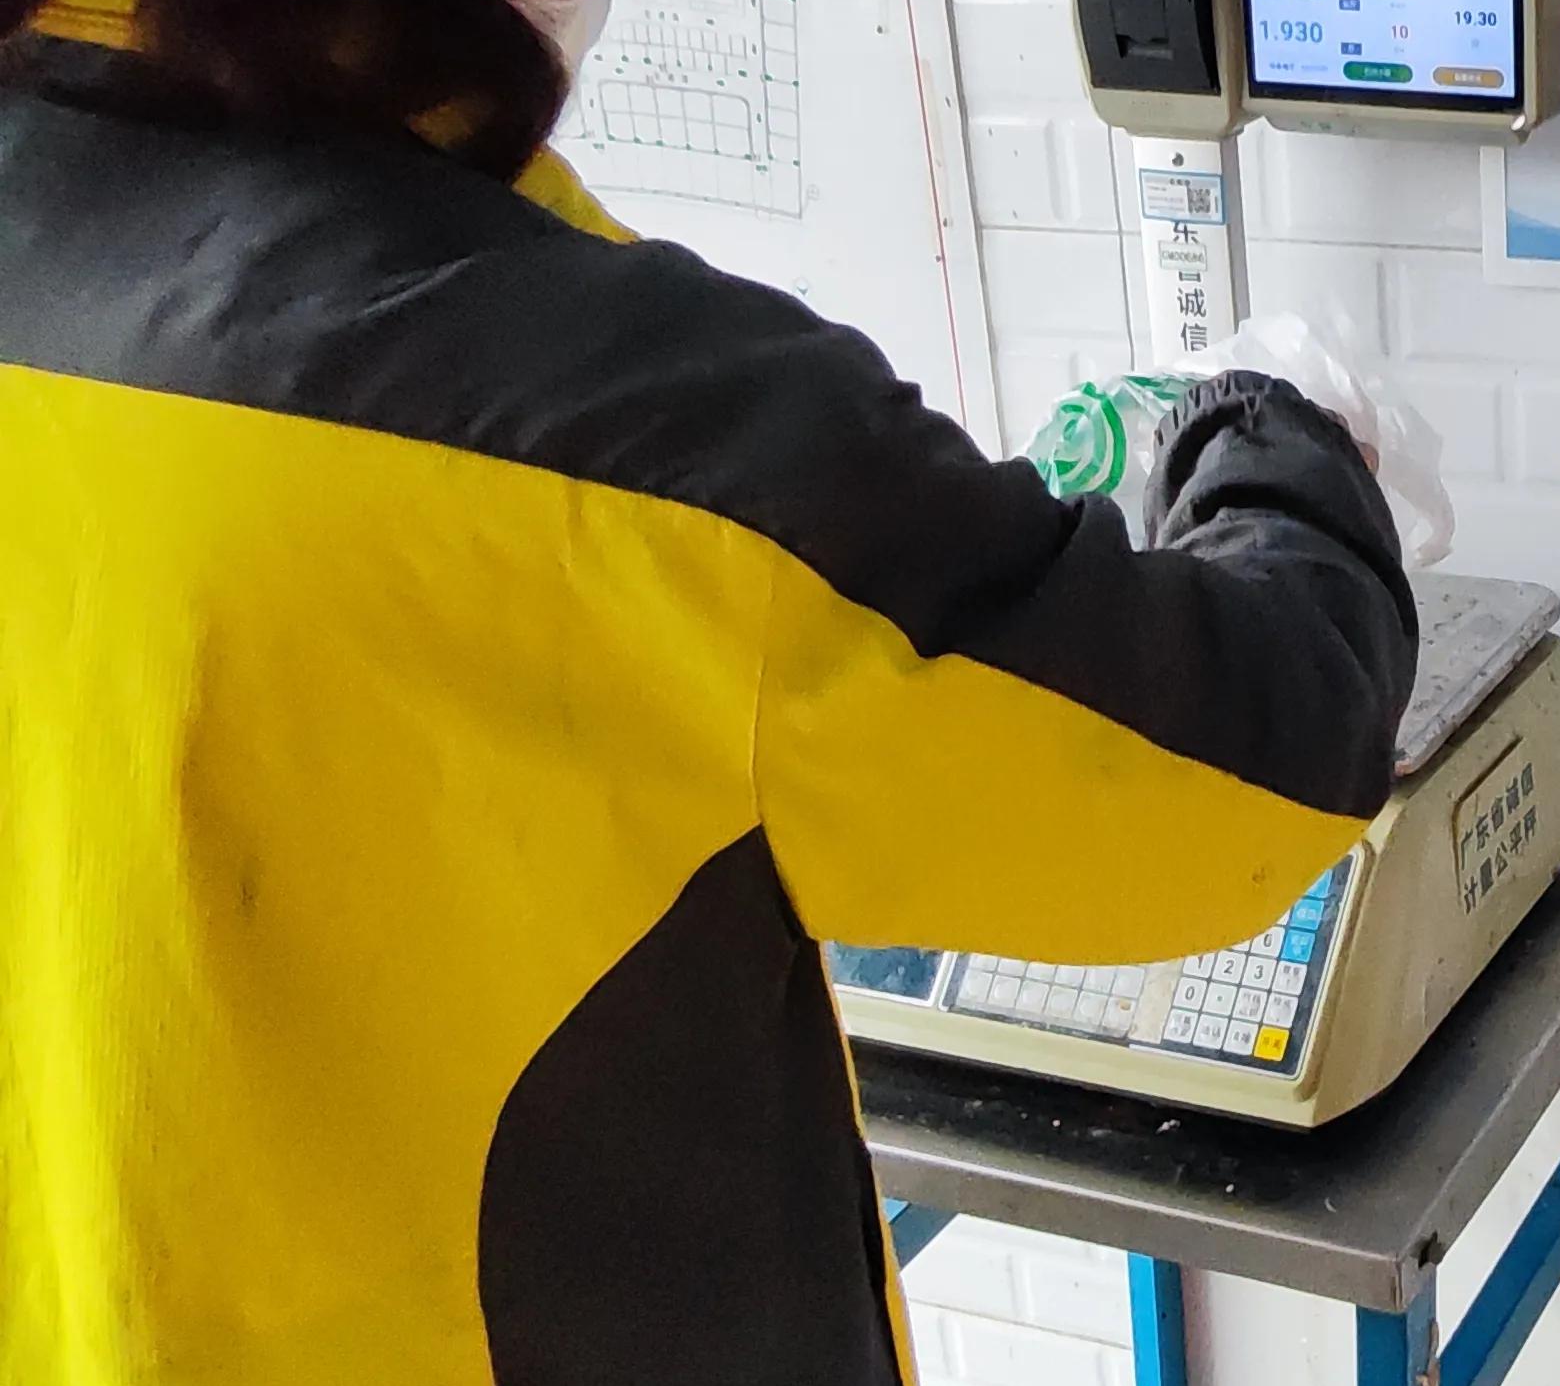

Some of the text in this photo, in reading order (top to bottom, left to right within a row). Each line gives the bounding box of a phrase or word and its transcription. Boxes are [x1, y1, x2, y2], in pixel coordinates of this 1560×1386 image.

[1454, 10, 1498, 26] 19.30
[1260, 20, 1324, 43] 1.930
[1391, 24, 1409, 39] 10
[1461, 762, 1535, 873] 广东省诚信
[1463, 804, 1537, 916] 计量公平秤
[1223, 959, 1236, 975] 2
[1254, 964, 1265, 980] 3
[1185, 985, 1196, 1000] 0
